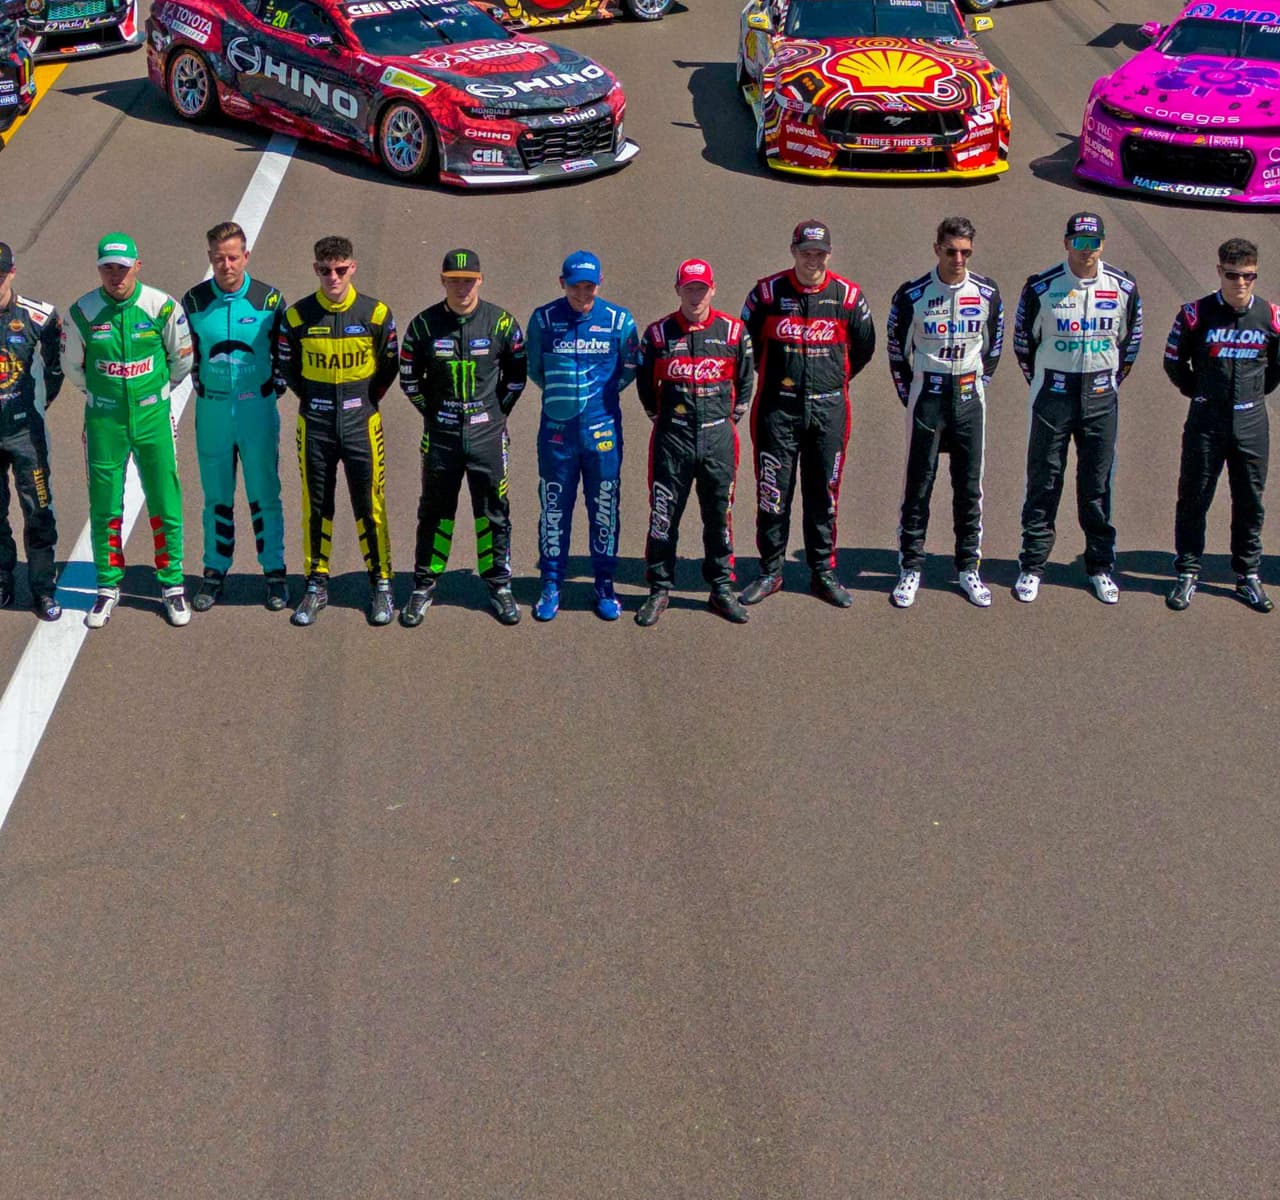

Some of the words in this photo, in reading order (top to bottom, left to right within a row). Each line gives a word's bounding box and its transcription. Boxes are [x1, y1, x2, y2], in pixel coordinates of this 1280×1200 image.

[347, 1, 387, 15] CEIL
[175, 6, 213, 36] TOYOTA
[271, 10, 289, 29] 20
[264, 56, 359, 120] HINO
[514, 65, 606, 94] HINO
[564, 108, 597, 124] HINO
[1144, 106, 1241, 125] coregas
[478, 131, 511, 141] HINO
[786, 124, 818, 139] pivotel
[862, 137, 892, 147] THREE
[892, 137, 928, 147] THREES
[472, 149, 505, 162] CEIL
[927, 295, 944, 309] nti
[776, 319, 839, 341] Coca-Cola
[924, 321, 965, 335] Mobil
[1056, 317, 1097, 332] Mobil
[552, 337, 610, 350] CoolDrive
[1205, 328, 1265, 344] NULON
[938, 344, 966, 361] nti
[1054, 338, 1111, 353] OPTUS
[107, 358, 151, 377] Castrol
[306, 348, 369, 370] TRADIE
[667, 357, 726, 381] Coca-Cola
[33, 469, 48, 509] PENRITE
[543, 481, 560, 558] CoolDrive
[591, 480, 611, 555] CoolDrive
